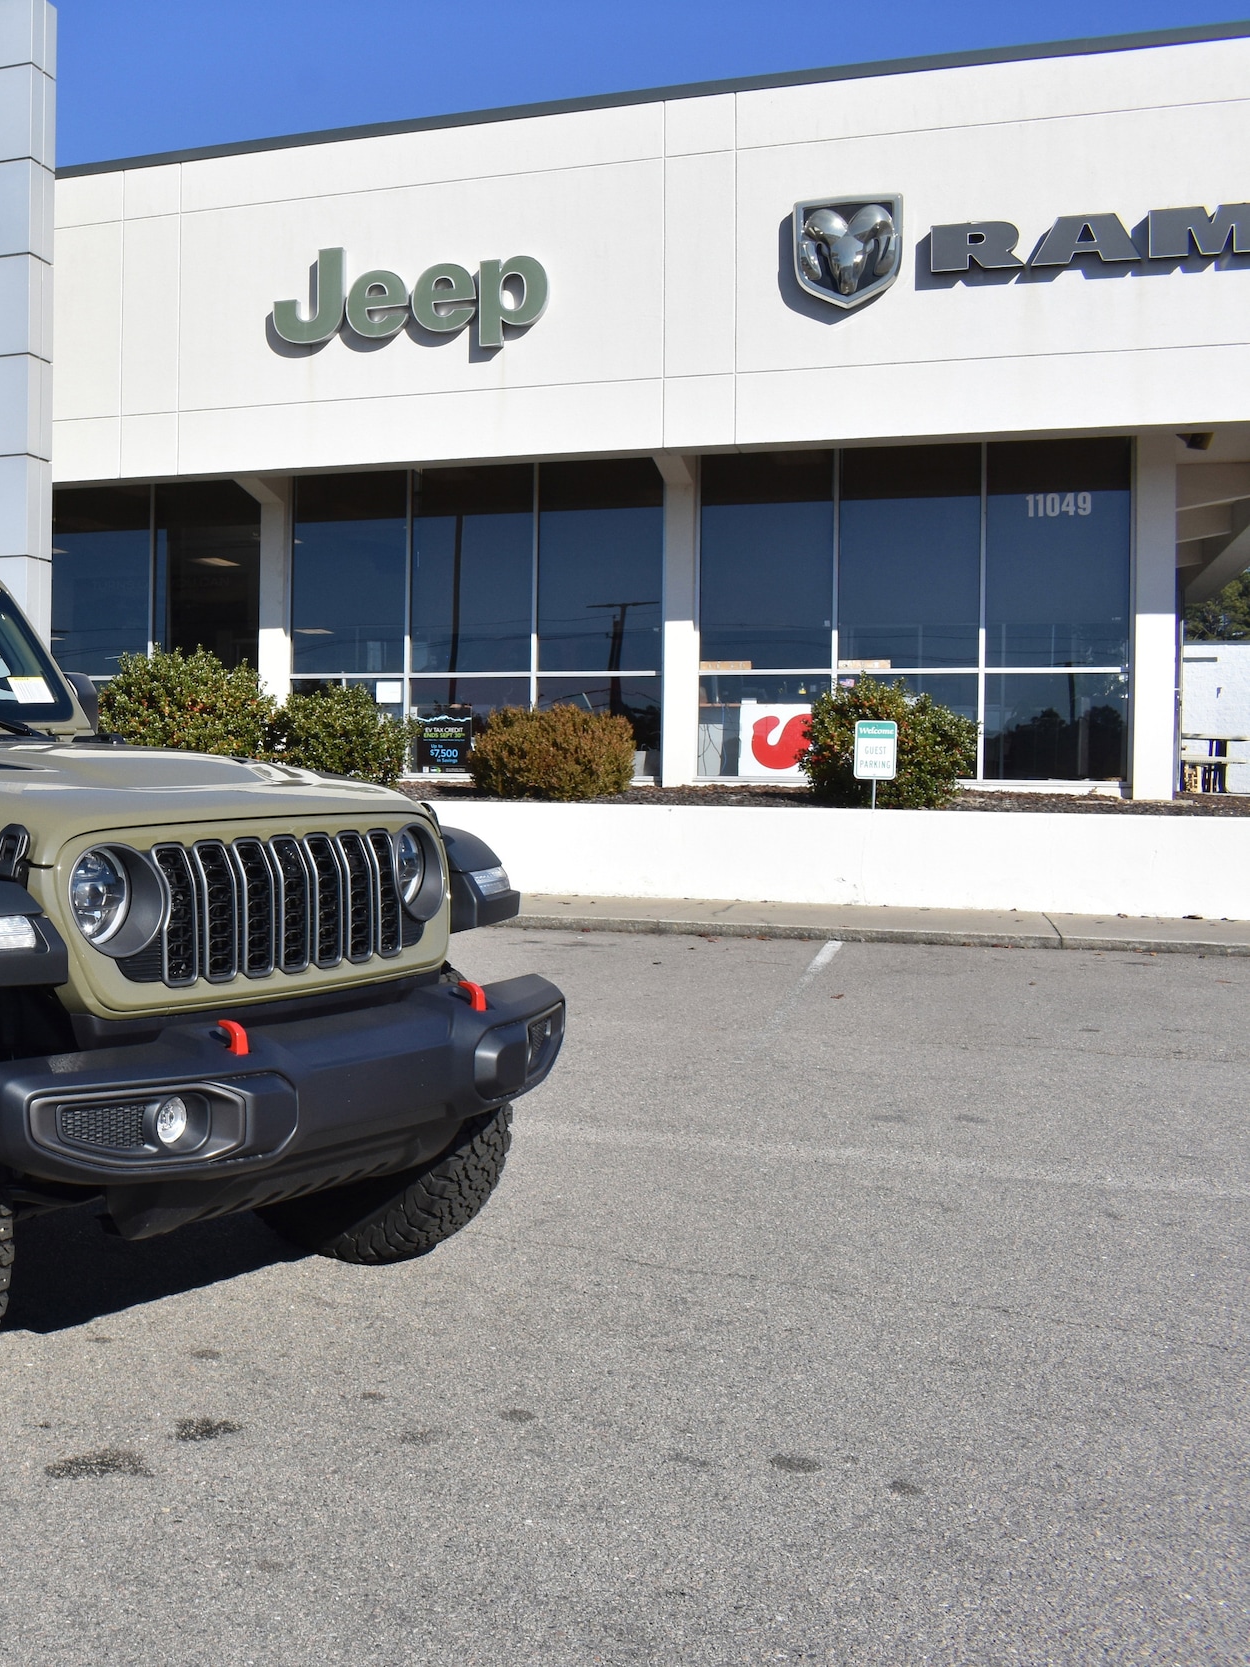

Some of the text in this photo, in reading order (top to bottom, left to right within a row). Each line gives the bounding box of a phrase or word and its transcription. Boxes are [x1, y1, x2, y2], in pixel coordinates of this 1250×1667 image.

[930, 202, 1250, 273] RAM
[272, 246, 549, 348] Jeep
[1025, 491, 1092, 518] 11049
[859, 727, 895, 735] Welcome
[430, 749, 458, 758] $7,500
[864, 745, 887, 755] GUEST
[859, 760, 891, 769] PARKING
